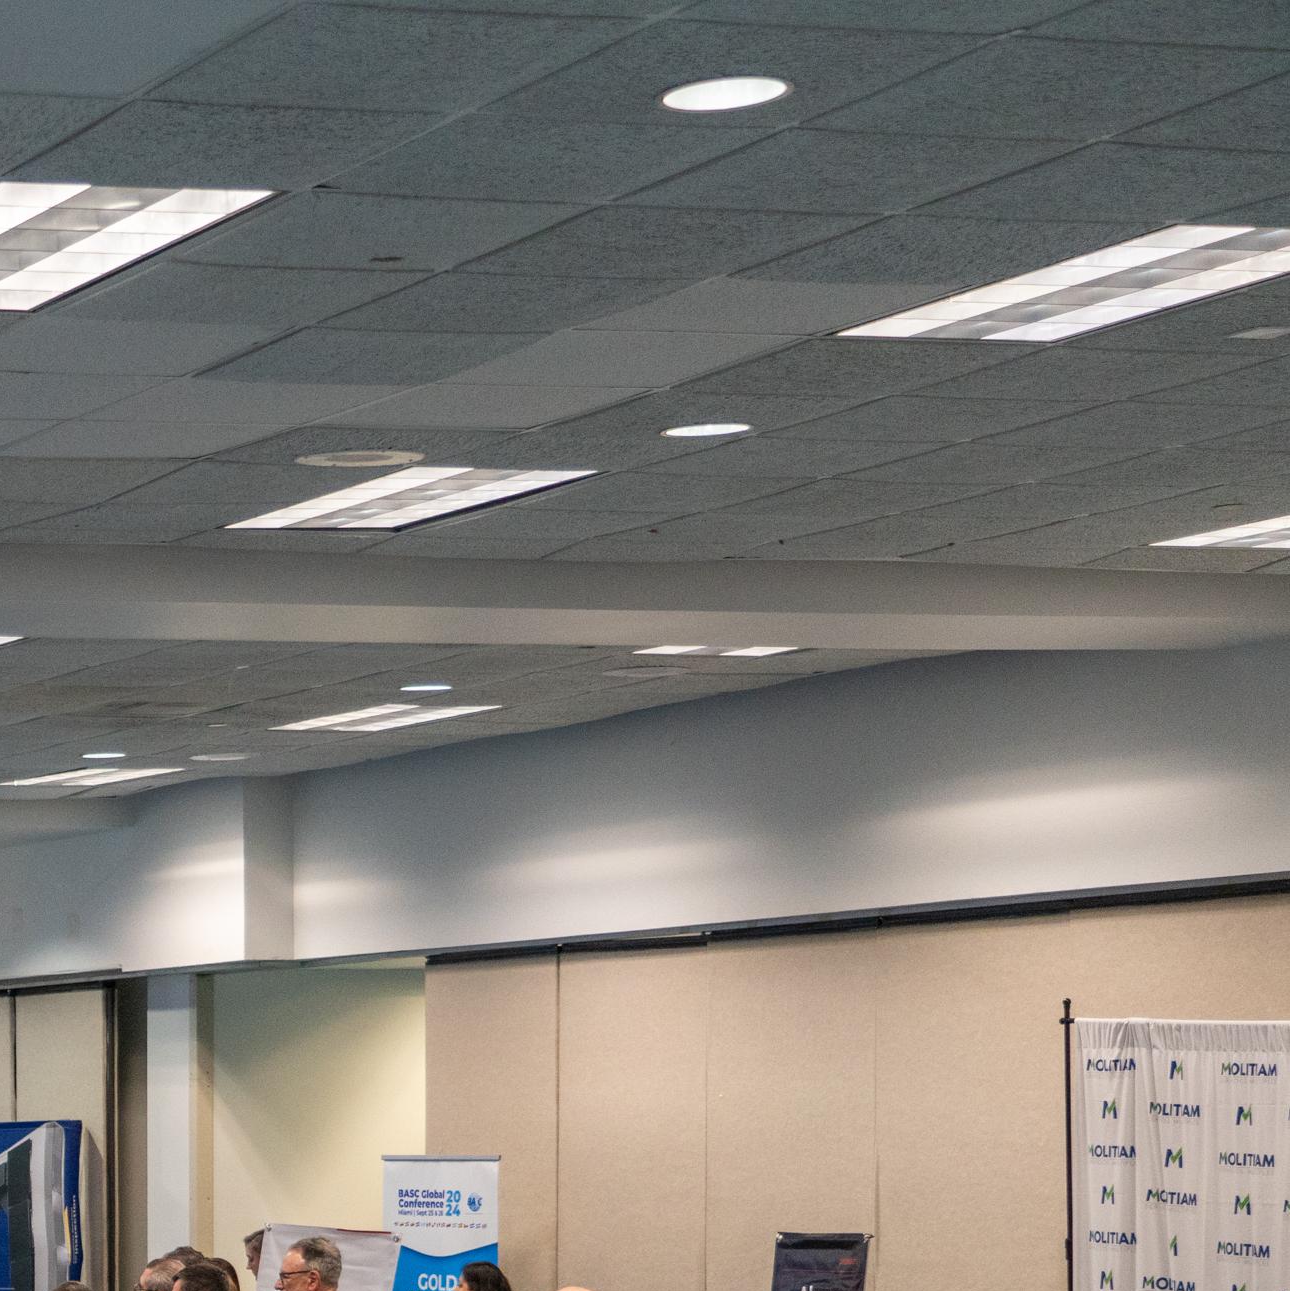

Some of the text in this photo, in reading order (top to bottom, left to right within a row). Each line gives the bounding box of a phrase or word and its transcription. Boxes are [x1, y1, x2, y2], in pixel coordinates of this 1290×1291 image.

[1220, 1062, 1277, 1077] MOLITIAM
[1219, 1152, 1275, 1168] MOLITIAM
[398, 1189, 445, 1199] BASC Global
[446, 1190, 462, 1203] 20
[398, 1199, 444, 1208] Conference
[445, 1204, 461, 1216] 24
[1217, 1241, 1270, 1258] MOLITIAM
[417, 1273, 457, 1291] GOLD
